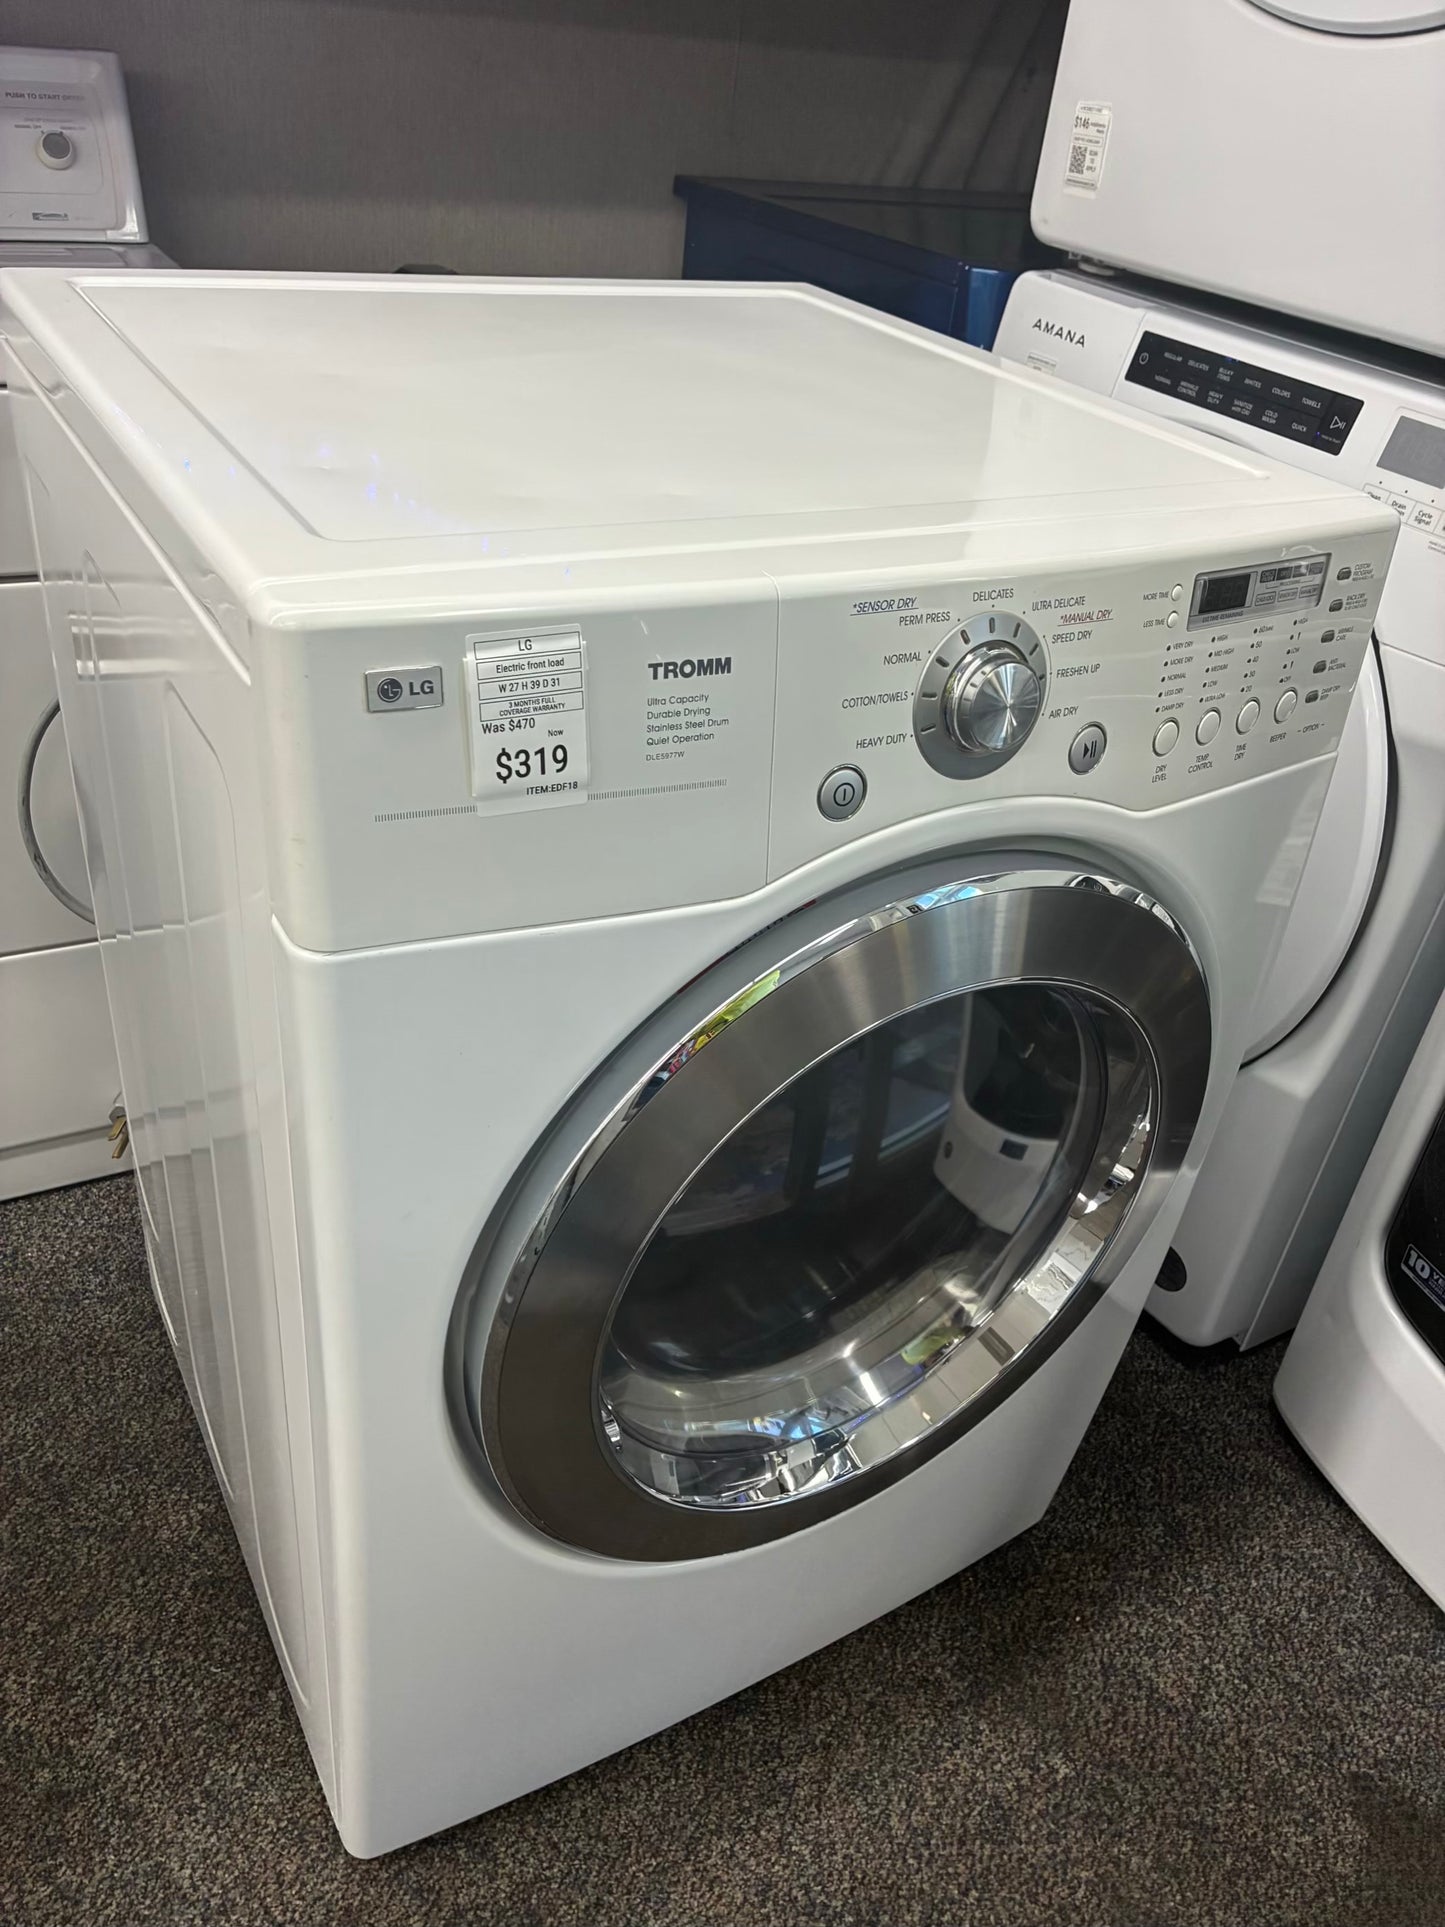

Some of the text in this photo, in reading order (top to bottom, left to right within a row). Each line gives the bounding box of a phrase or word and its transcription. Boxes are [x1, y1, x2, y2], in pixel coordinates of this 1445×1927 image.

[1032, 318, 1085, 348] AMANA
[1209, 391, 1224, 399] HEAVY
[1272, 387, 1290, 398] COLORS
[1302, 398, 1321, 408] TOWELS
[1265, 410, 1278, 418] COLD
[1292, 423, 1307, 432] QUICK
[1392, 500, 1406, 510] Drain
[1415, 516, 1431, 525] Signal
[1418, 511, 1433, 519] Cycle
[973, 588, 1014, 602] DELICATES
[897, 597, 917, 608] DRY
[1032, 596, 1085, 611] ULTRA DELICATE
[899, 611, 950, 626] PERM PRESS
[1096, 609, 1112, 620] DRY
[1143, 620, 1154, 628] LESS
[1052, 630, 1093, 644] SPEED DRY
[518, 640, 532, 651] LG
[884, 652, 922, 666] NORMAL
[496, 658, 565, 673] Electric front load
[648, 657, 731, 680] TROMM
[1056, 664, 1100, 678] FRESHEN UP
[409, 680, 434, 695] LG
[499, 678, 561, 693] W 27 H 39 D 31
[514, 698, 540, 707] MONTHS
[647, 694, 709, 706] Ultra Capacity
[842, 692, 908, 709] COTTON/TOWELS
[499, 703, 565, 716] COVERAGE WARRANTY
[647, 707, 711, 720] Durable Drying
[1049, 706, 1079, 719] AIR DRY
[482, 718, 535, 734] Was $470
[647, 718, 729, 733] Stainless Steel Drum
[1303, 724, 1319, 733] OPTION
[548, 729, 564, 737] Now
[1269, 733, 1286, 743] BEEPER
[647, 733, 714, 746] Quiet Operation
[856, 733, 907, 749] HEAVY DUTY
[1236, 743, 1247, 752] TIME
[646, 751, 685, 761] DLE5977W
[1196, 753, 1209, 762] TEMP
[1234, 752, 1245, 760] DRY
[496, 744, 568, 784] $319
[1156, 764, 1167, 773] DRY
[1188, 762, 1213, 773] CONTROL
[1152, 774, 1166, 783] LEVEL
[526, 782, 578, 795] ITEM:EDF18
[1408, 1250, 1430, 1279] 10
